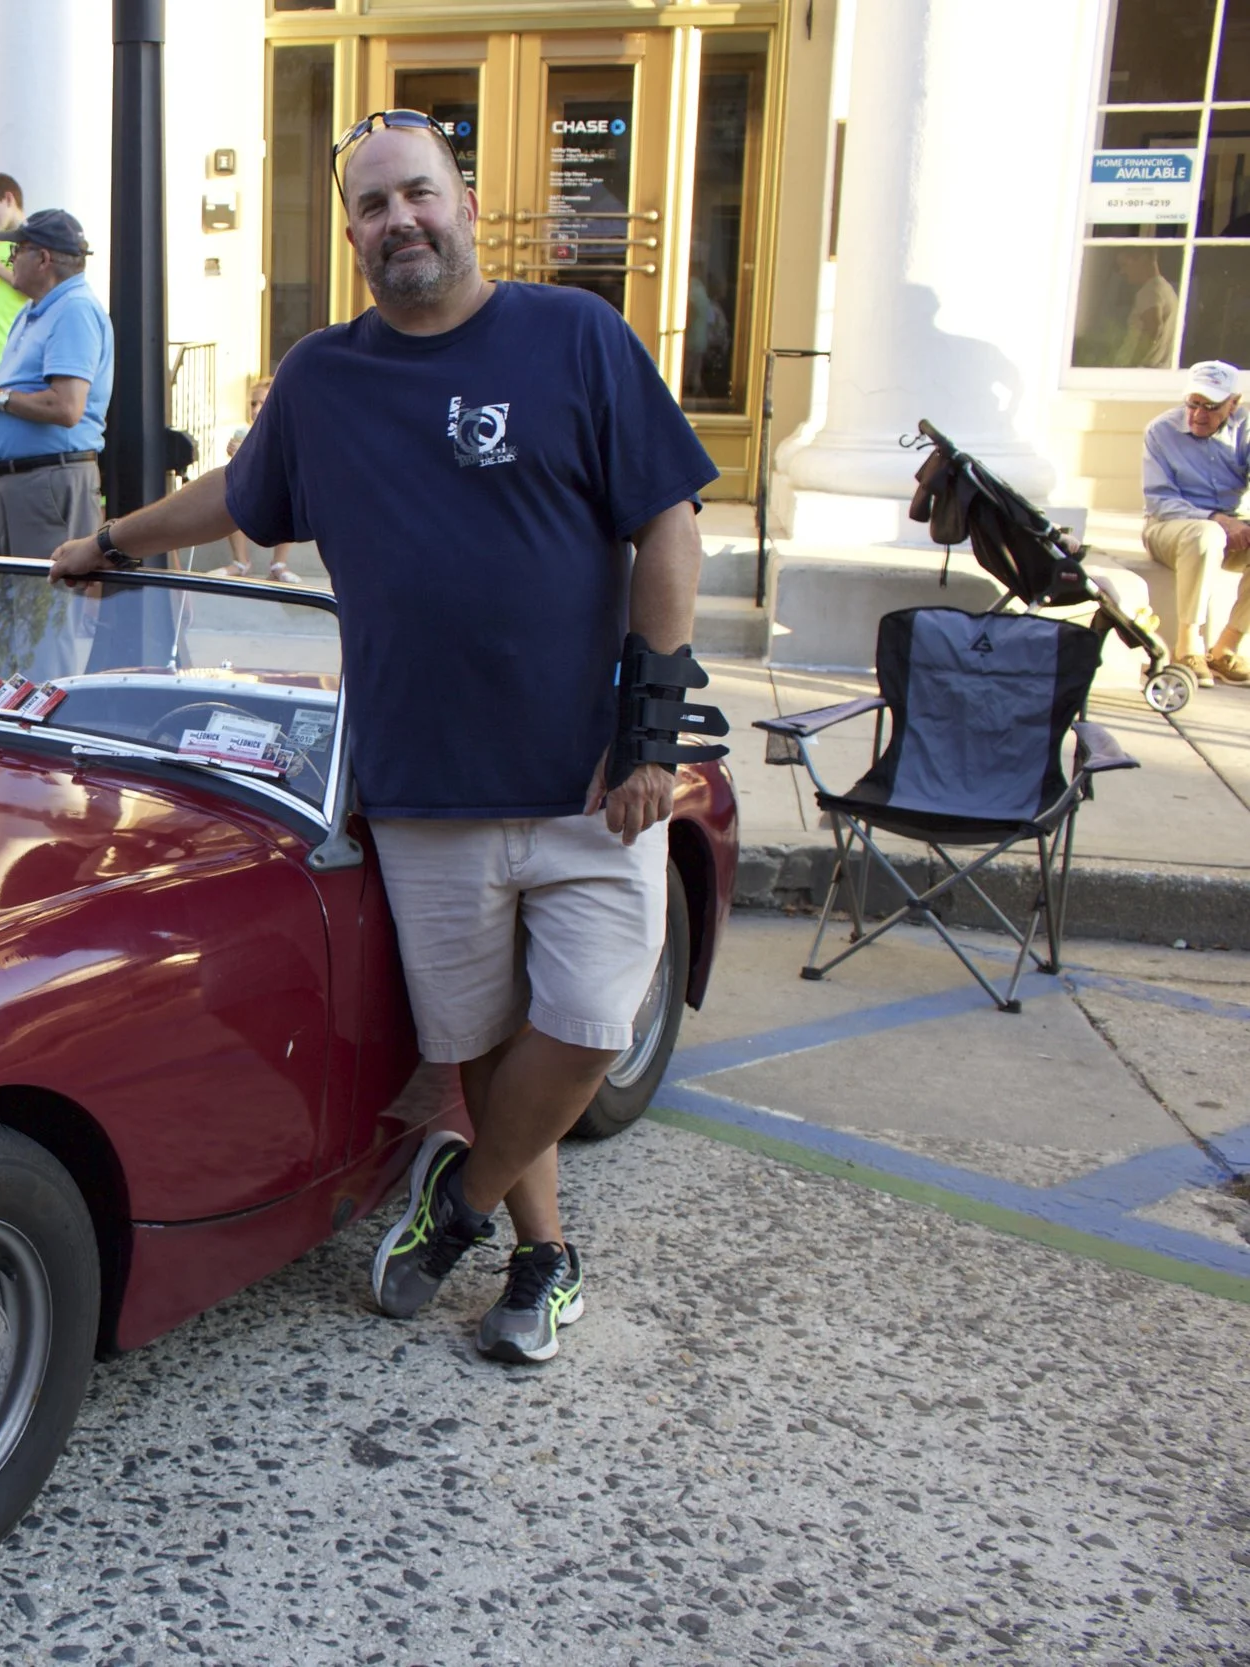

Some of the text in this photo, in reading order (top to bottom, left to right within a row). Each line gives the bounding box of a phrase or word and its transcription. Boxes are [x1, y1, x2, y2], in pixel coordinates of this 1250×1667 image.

[552, 120, 609, 133] CHASE
[1096, 158, 1174, 168] HOME FINANCING
[1115, 167, 1187, 179] AVAILABLE
